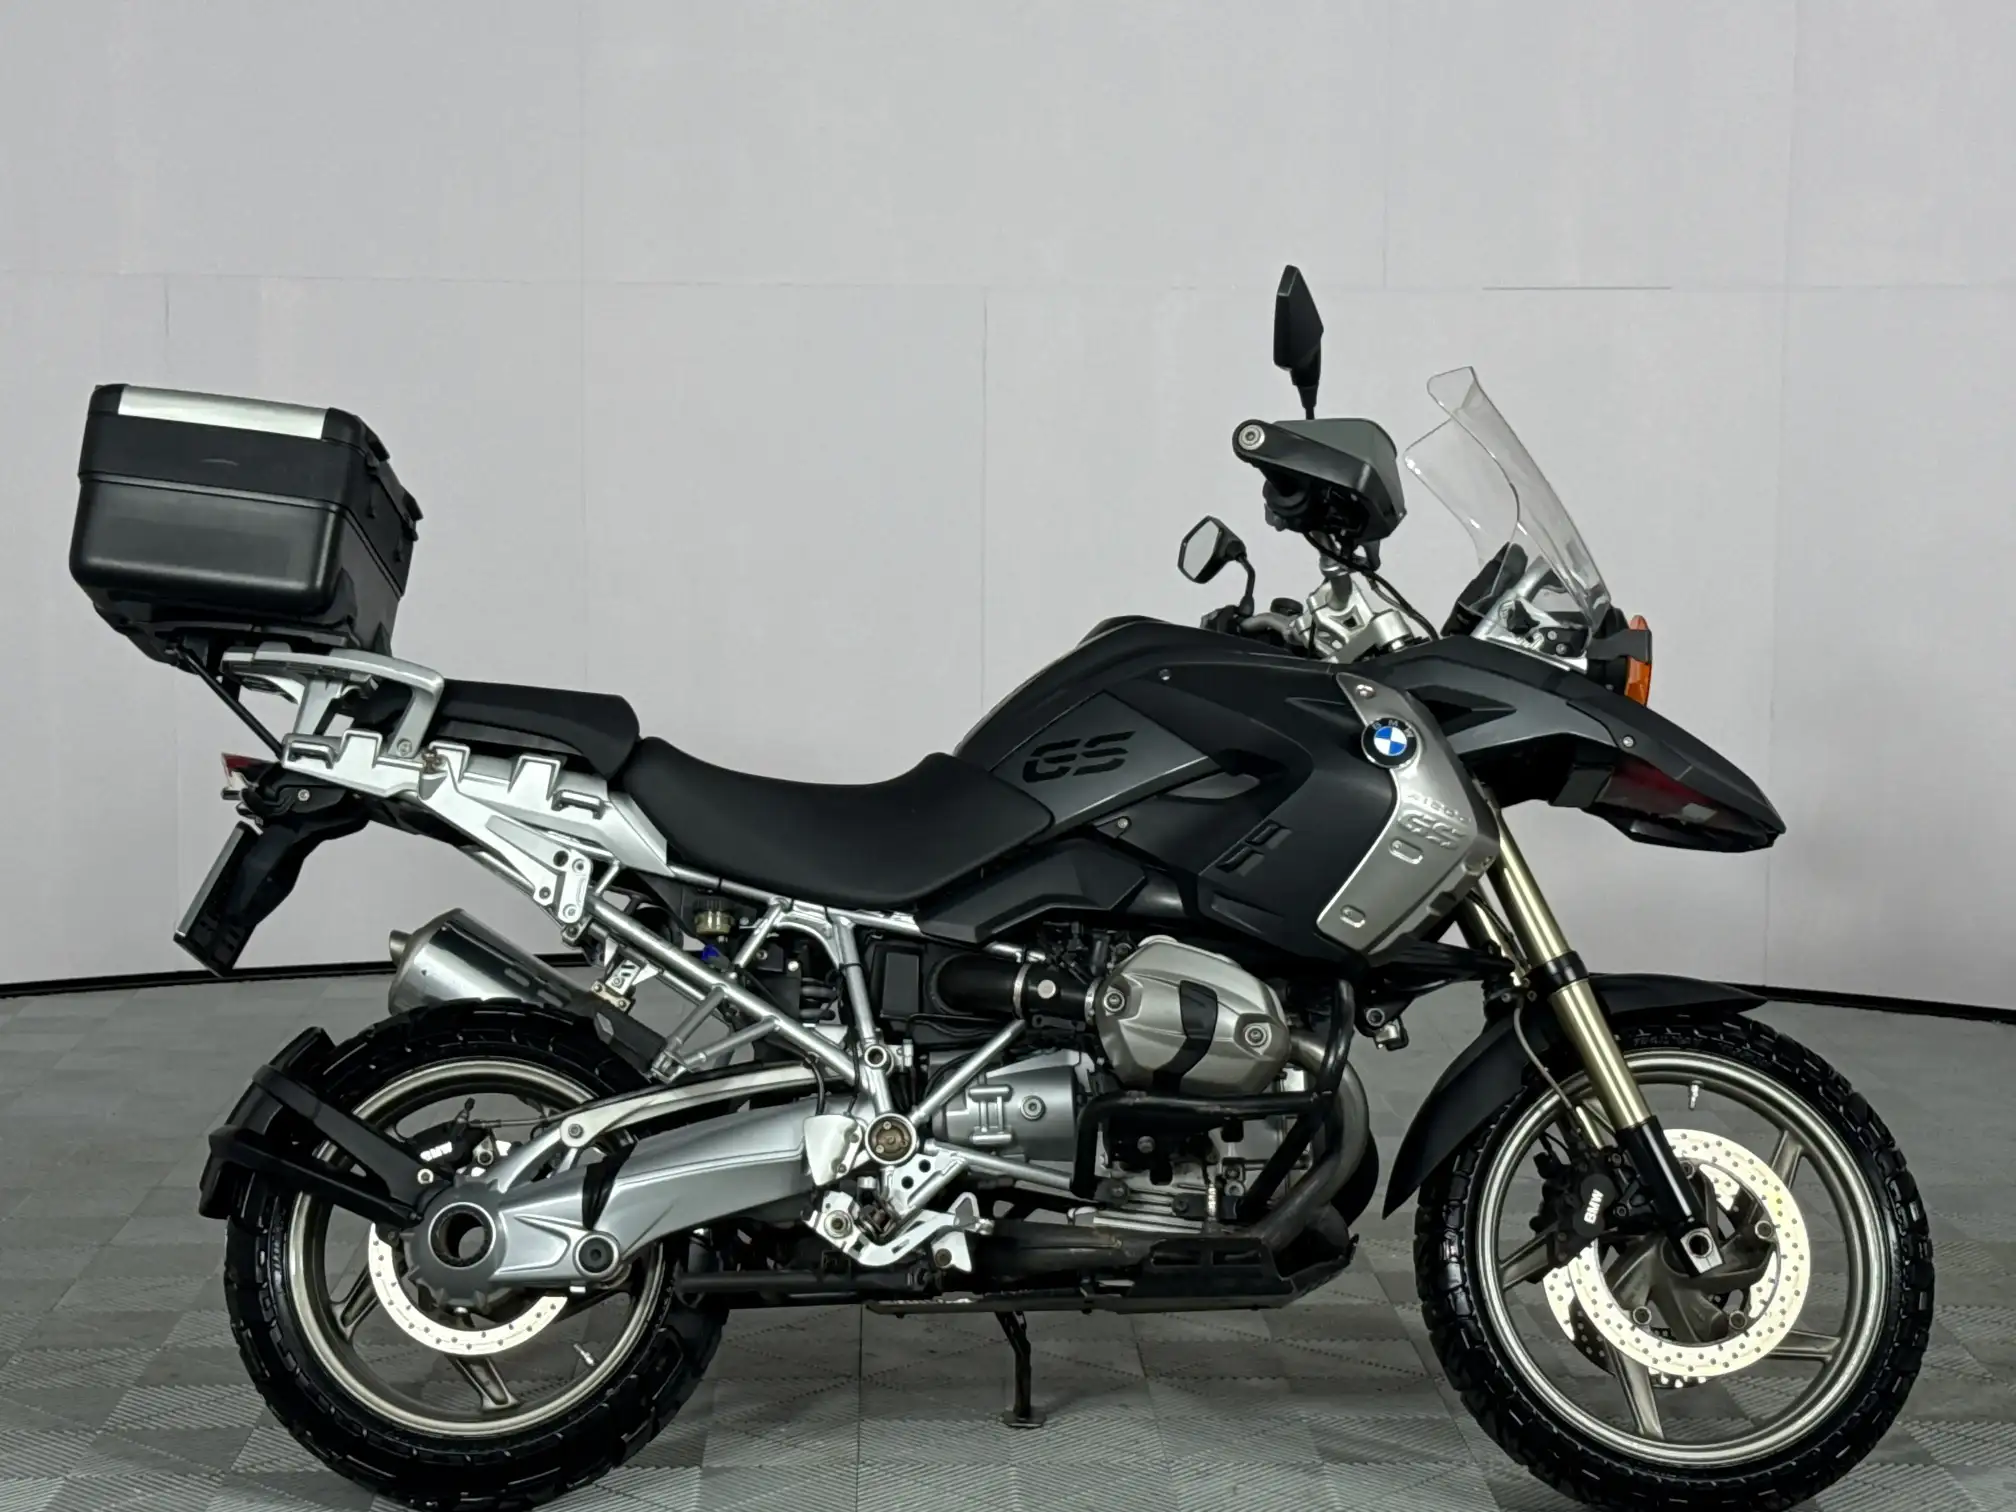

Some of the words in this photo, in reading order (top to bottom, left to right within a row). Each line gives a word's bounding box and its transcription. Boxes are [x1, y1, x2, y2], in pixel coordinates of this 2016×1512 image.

[1372, 719, 1414, 738] BMW
[1022, 730, 1136, 783] GS
[1583, 1188, 1604, 1225] BMW
